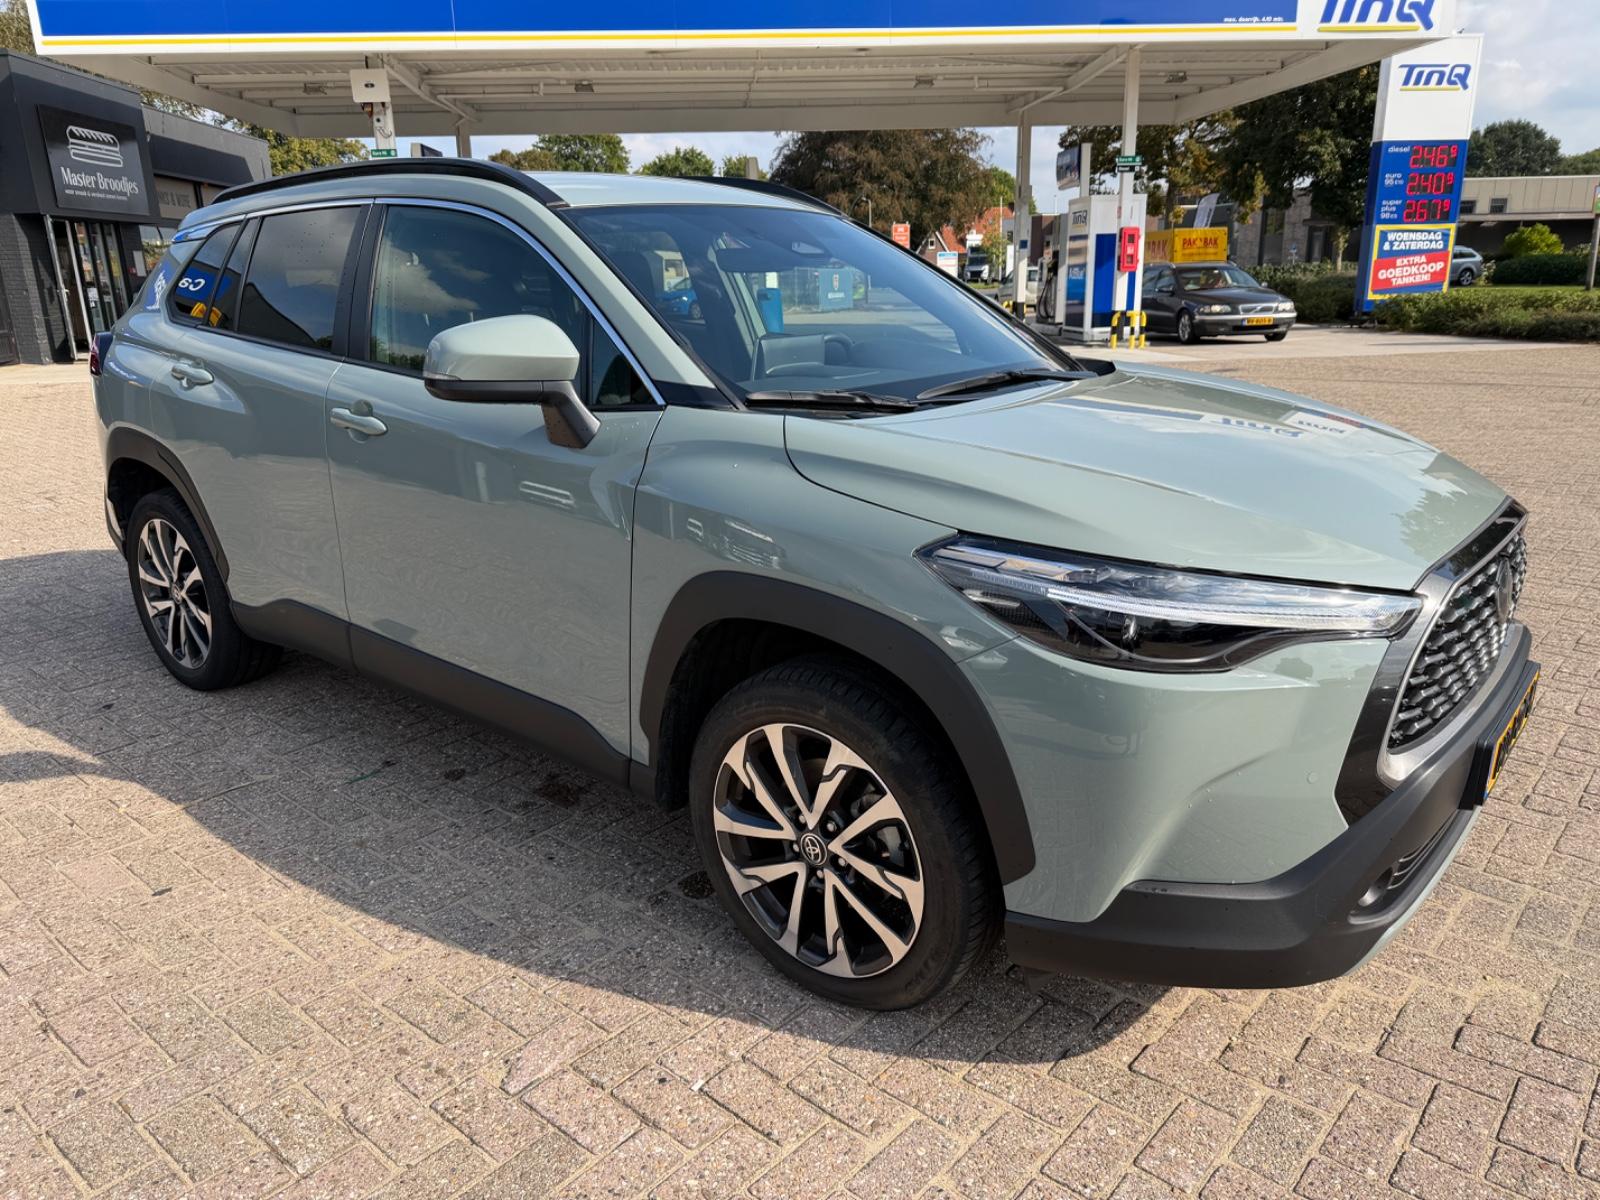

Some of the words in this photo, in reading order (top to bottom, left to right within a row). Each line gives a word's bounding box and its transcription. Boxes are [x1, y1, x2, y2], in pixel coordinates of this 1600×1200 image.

[1398, 63, 1471, 91] TinQ
[1388, 145, 1410, 153] diesel
[60, 166, 97, 188] Master
[96, 171, 139, 197] Broodjes
[1387, 231, 1442, 242] WOENSDAG
[1383, 241, 1391, 251] &
[1392, 241, 1444, 251] ZATERDAG
[1396, 255, 1427, 266] EXTRA
[1378, 262, 1445, 280] GOEDKOOP
